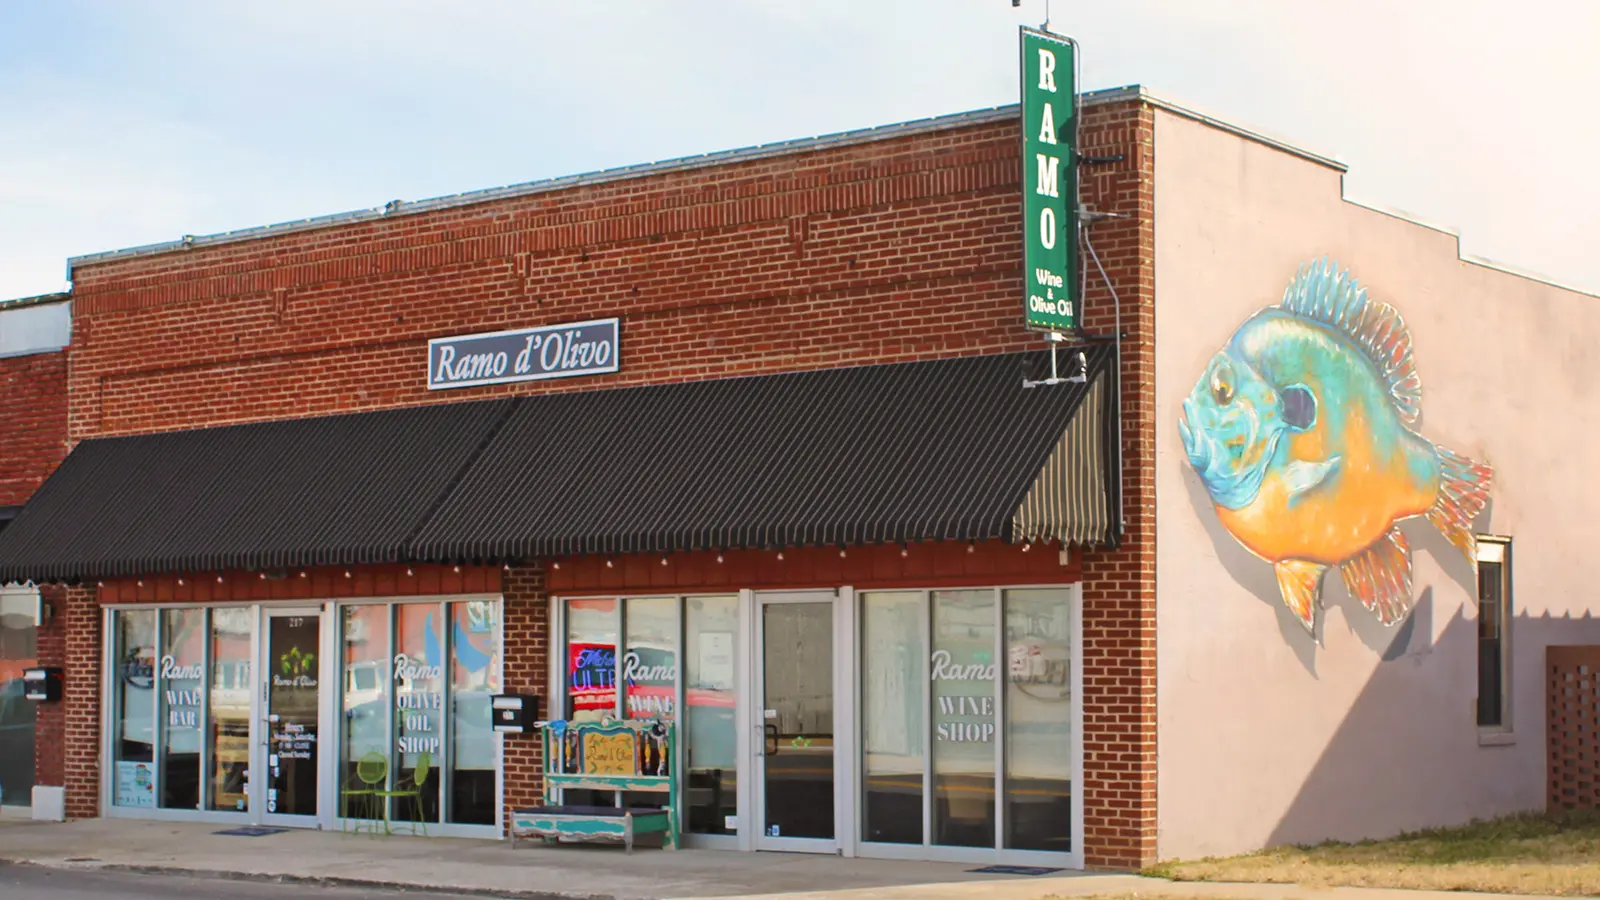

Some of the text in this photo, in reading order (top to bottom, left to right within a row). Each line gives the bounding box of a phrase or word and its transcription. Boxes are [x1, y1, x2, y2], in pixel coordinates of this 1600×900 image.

[1036, 48, 1059, 250] RAMO
[1036, 268, 1063, 288] Wine
[1047, 287, 1054, 300] &
[1030, 295, 1073, 317] Olive Oil
[434, 330, 611, 382] Ramo d'Olivo
[161, 655, 202, 679] Ramo
[394, 653, 440, 680] Ramo
[624, 651, 676, 681] Ramo
[931, 649, 995, 681] Ramo
[166, 690, 200, 705] WINE
[397, 694, 440, 709] OLIVE
[938, 696, 993, 716] WINE
[170, 711, 197, 726] BAR
[406, 715, 432, 731] OIL
[937, 722, 994, 742] SHOP
[398, 736, 438, 753] SHOP
